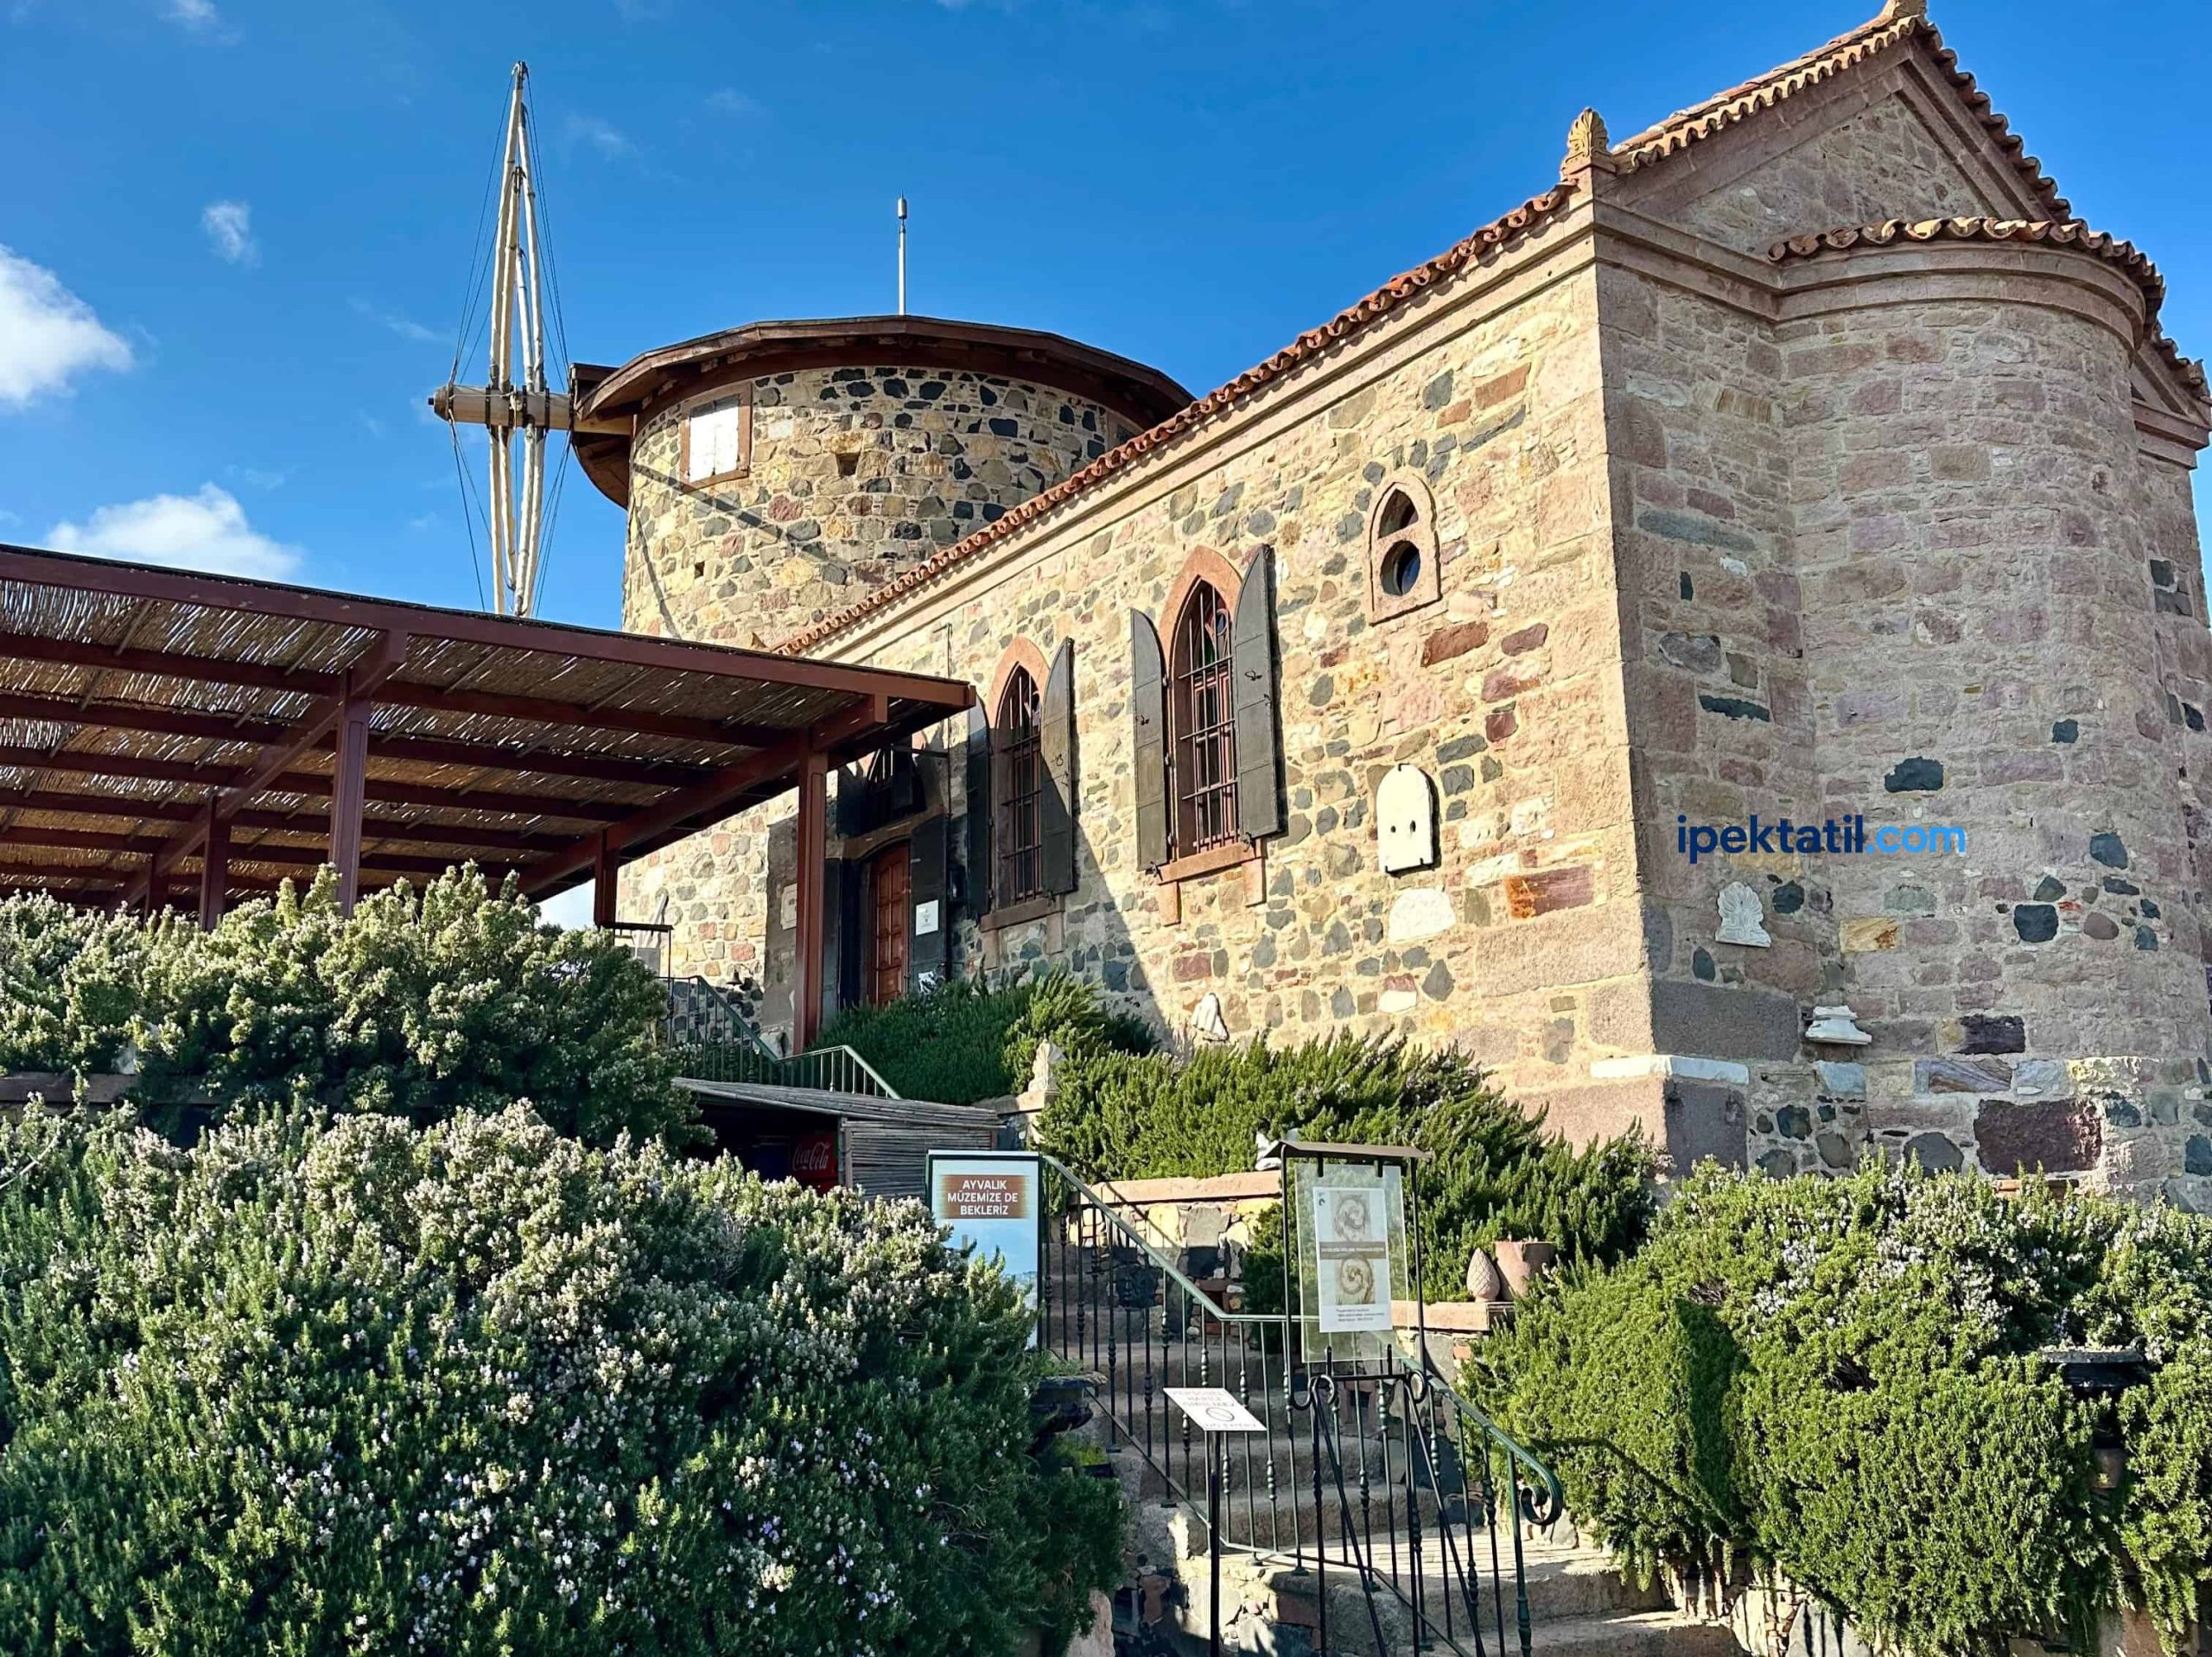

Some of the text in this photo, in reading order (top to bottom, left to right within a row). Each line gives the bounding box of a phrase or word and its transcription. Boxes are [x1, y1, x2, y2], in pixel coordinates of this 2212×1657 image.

[962, 1180, 1007, 1190] AYVALIK
[947, 1190, 1018, 1203] MÜZEMİZE DE
[960, 1203, 1008, 1216] BEKLERİZ
